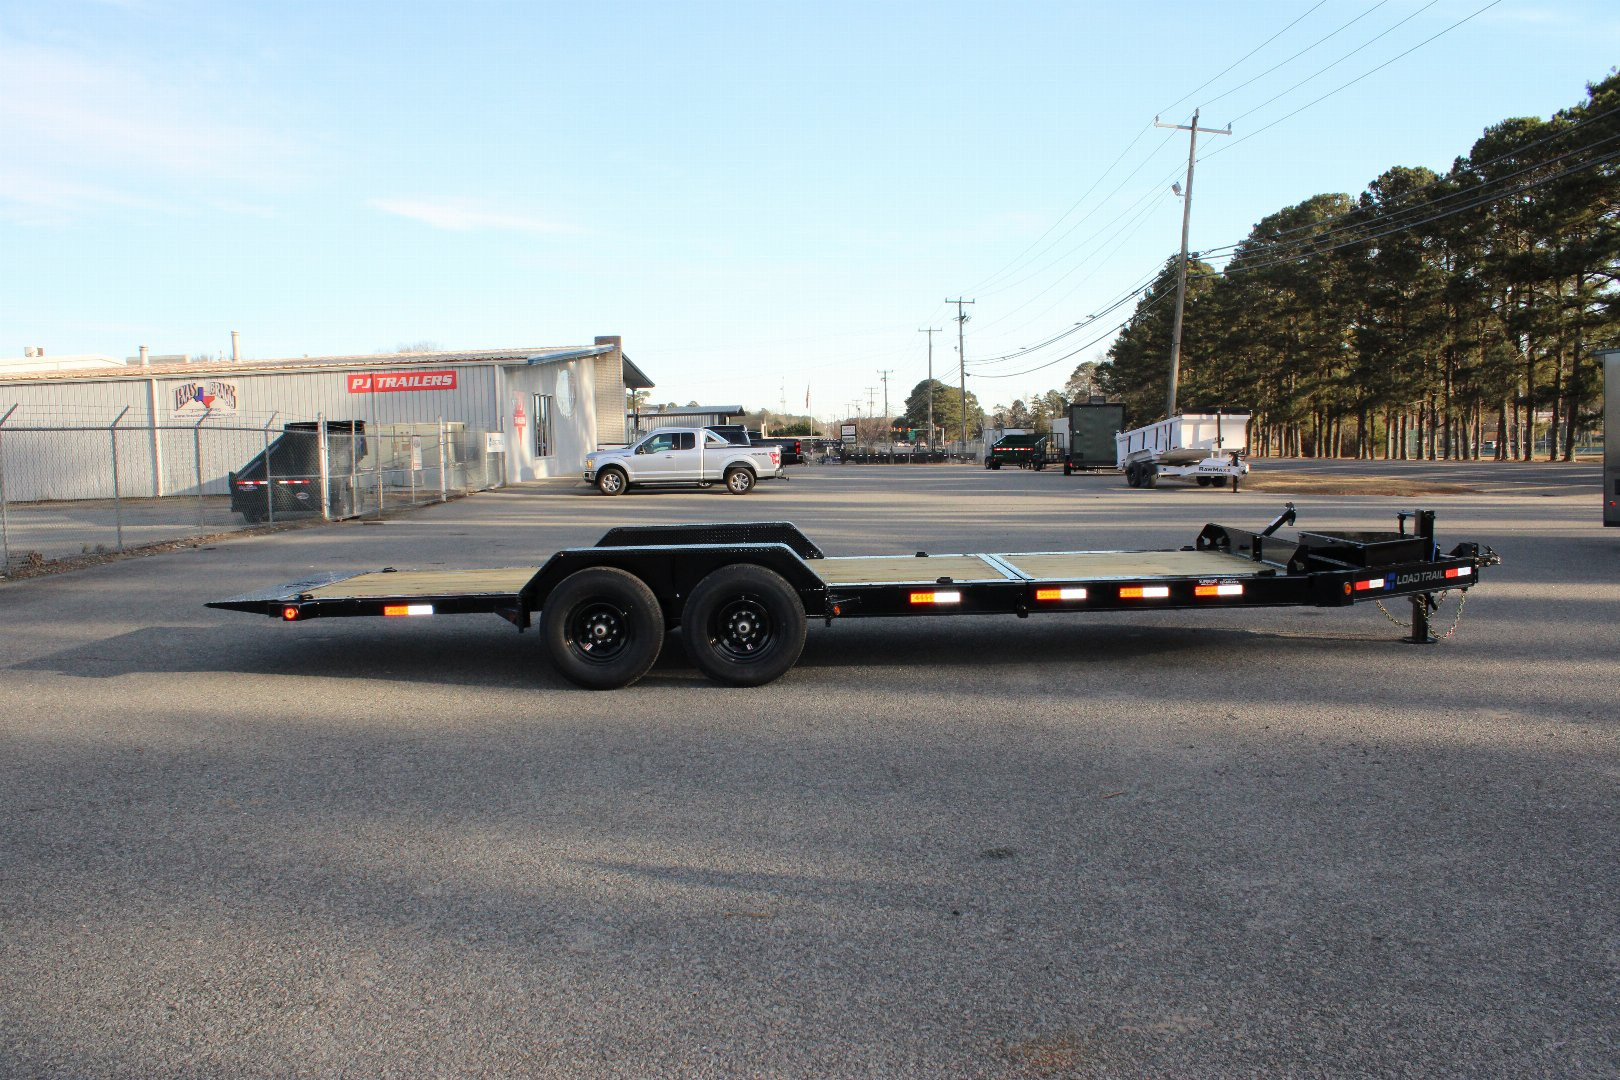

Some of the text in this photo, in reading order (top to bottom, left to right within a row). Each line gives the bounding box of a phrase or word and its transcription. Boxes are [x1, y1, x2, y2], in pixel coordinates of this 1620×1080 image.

[352, 374, 453, 390] PJ TRAILERS
[172, 382, 236, 411] TEXAS BRAGG
[1397, 570, 1445, 585] LOAD TRAIL
